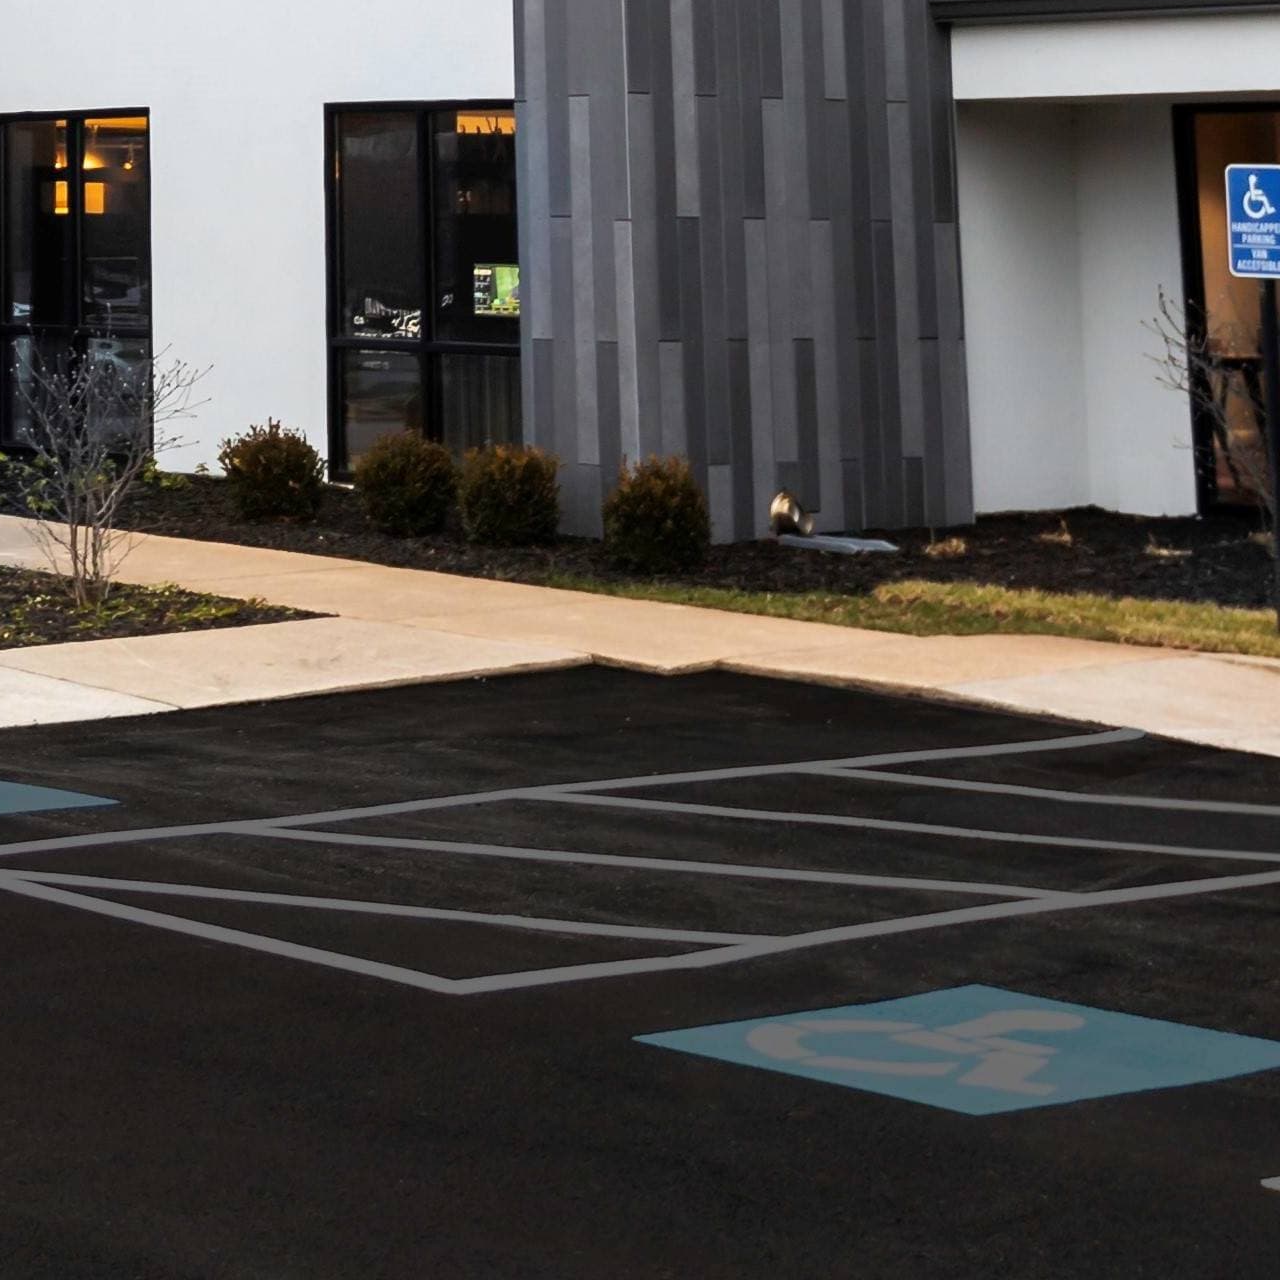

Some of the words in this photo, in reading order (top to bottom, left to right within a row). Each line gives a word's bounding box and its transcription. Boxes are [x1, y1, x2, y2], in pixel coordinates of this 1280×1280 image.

[1231, 221, 1280, 235] HANDICAPPE
[1241, 233, 1276, 245] PARKING
[1251, 248, 1268, 259] VAN
